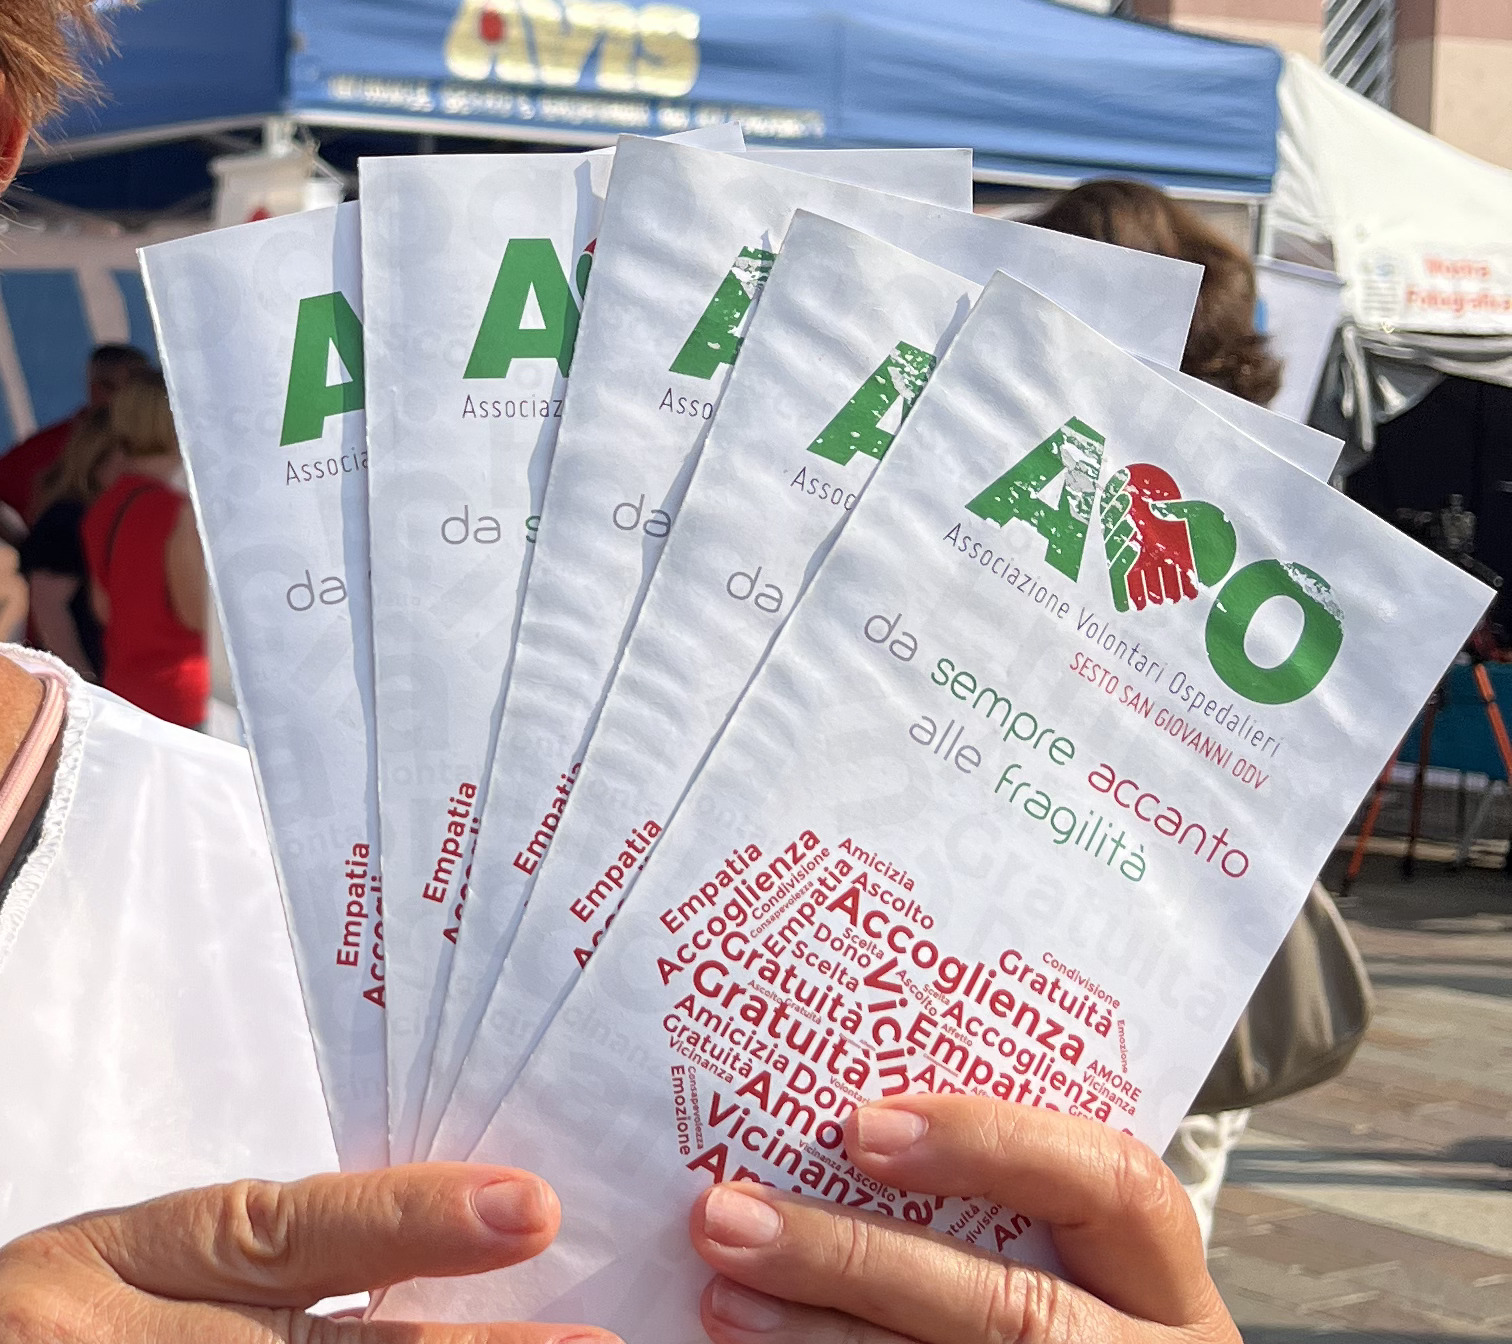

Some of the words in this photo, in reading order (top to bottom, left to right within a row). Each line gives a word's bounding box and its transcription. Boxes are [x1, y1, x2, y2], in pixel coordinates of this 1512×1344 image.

[441, 505, 501, 545] da
[612, 494, 672, 538] da
[286, 570, 347, 612] da
[726, 566, 784, 613] da
[943, 522, 1070, 620] Associazione
[1076, 604, 1166, 686] Volontari
[1169, 670, 1283, 755] Ospedalieri
[864, 612, 919, 663] da
[931, 656, 1076, 766] sempre
[1088, 762, 1251, 879] accanto
[1069, 650, 1119, 699] SESTO
[1119, 682, 1154, 720] SAN
[1155, 703, 1231, 774] GIOVANNI
[1232, 750, 1269, 791] ODV
[909, 714, 982, 774] alle
[994, 762, 1147, 884] fragilità
[423, 782, 477, 903] Empatia
[569, 819, 662, 923] Empatia
[838, 837, 915, 892] Amicizia
[336, 842, 371, 967] Empatia
[657, 829, 820, 986] Accoglienza
[659, 843, 763, 934] Empatia
[752, 847, 830, 921] Condivisione
[762, 859, 853, 958] Empatia
[851, 871, 934, 930] Ascolto
[721, 931, 863, 1034] Gratuità
[791, 940, 859, 993] Scelta
[813, 922, 871, 968] Dono
[826, 885, 1085, 1066] Accoglienza
[842, 927, 885, 960] Scelta
[1042, 952, 1120, 1009] Condivisione
[674, 993, 789, 1074] Amicizia
[693, 960, 871, 1091] Gratuità
[896, 969, 937, 1017] Ascolto
[999, 949, 1113, 1038] Gratuità
[663, 1013, 755, 1079] Gratuità
[669, 1036, 735, 1084] Vicinanza
[906, 1011, 1061, 1113] Empati
[941, 999, 1112, 1123] Accoglienza
[1087, 1059, 1142, 1102] AMORE
[671, 1065, 690, 1155] Emozione
[1083, 1071, 1136, 1116] Vicinanza
[844, 1166, 896, 1202] Ascolto
